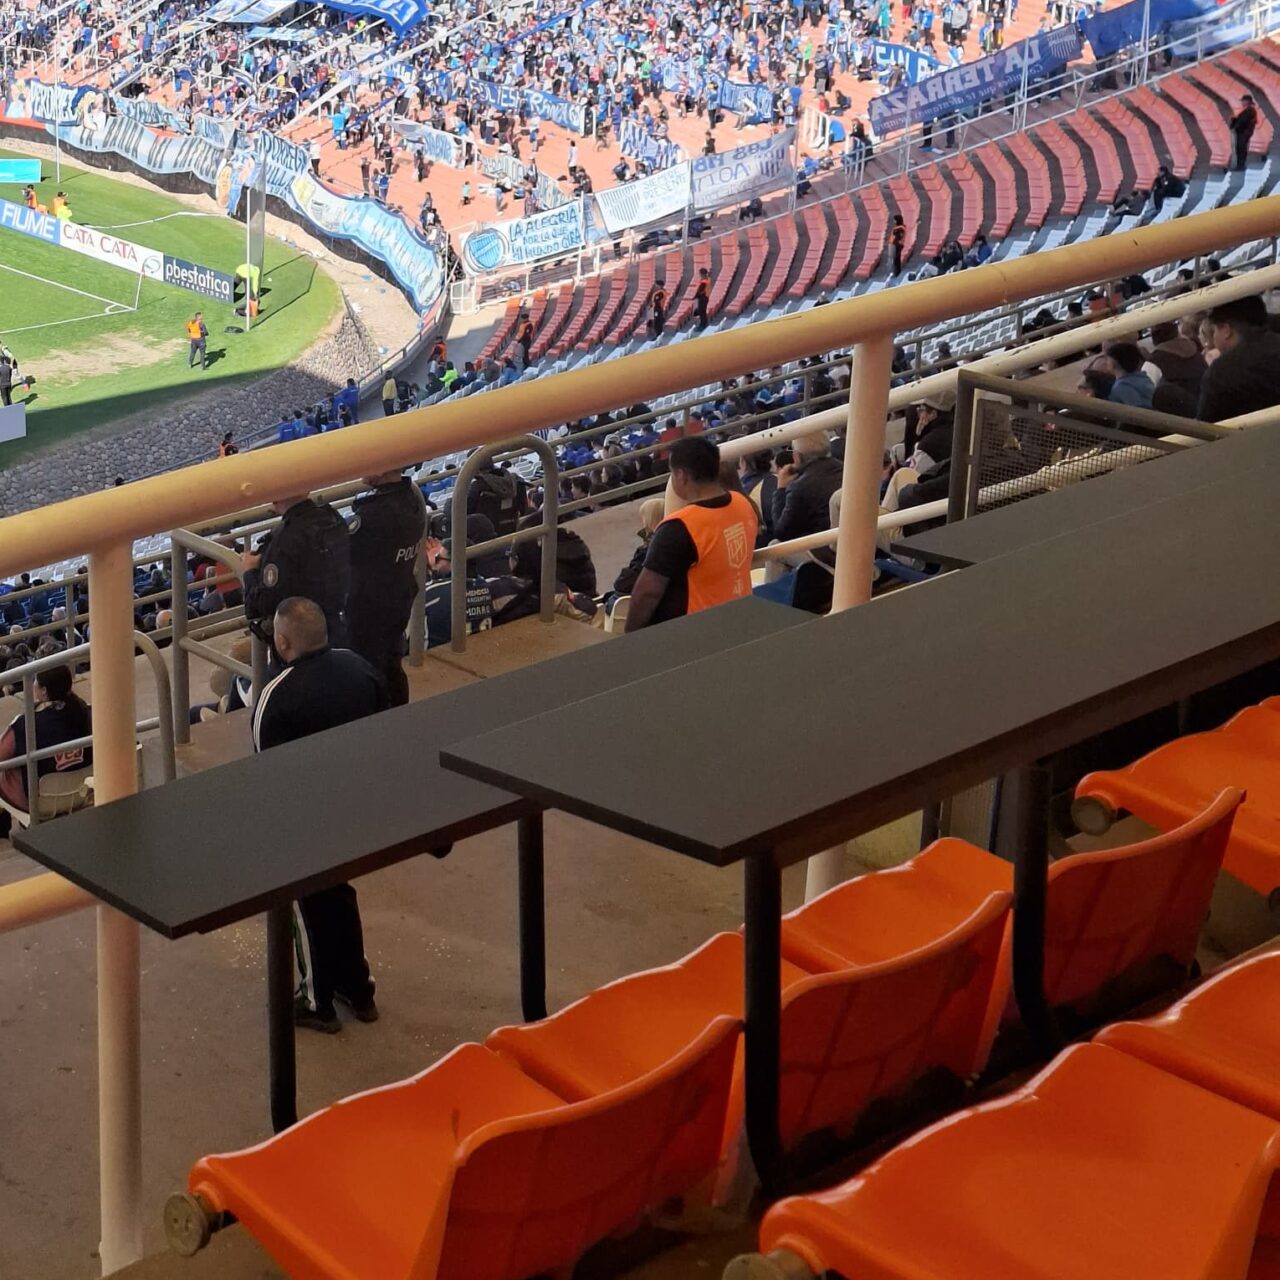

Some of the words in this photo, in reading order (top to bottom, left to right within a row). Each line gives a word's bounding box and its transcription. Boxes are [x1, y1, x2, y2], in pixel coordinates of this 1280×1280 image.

[525, 205, 578, 235] ALEGRIA
[63, 223, 95, 248] CATA
[99, 236, 138, 263] CATA
[165, 258, 230, 293] pbestatica
